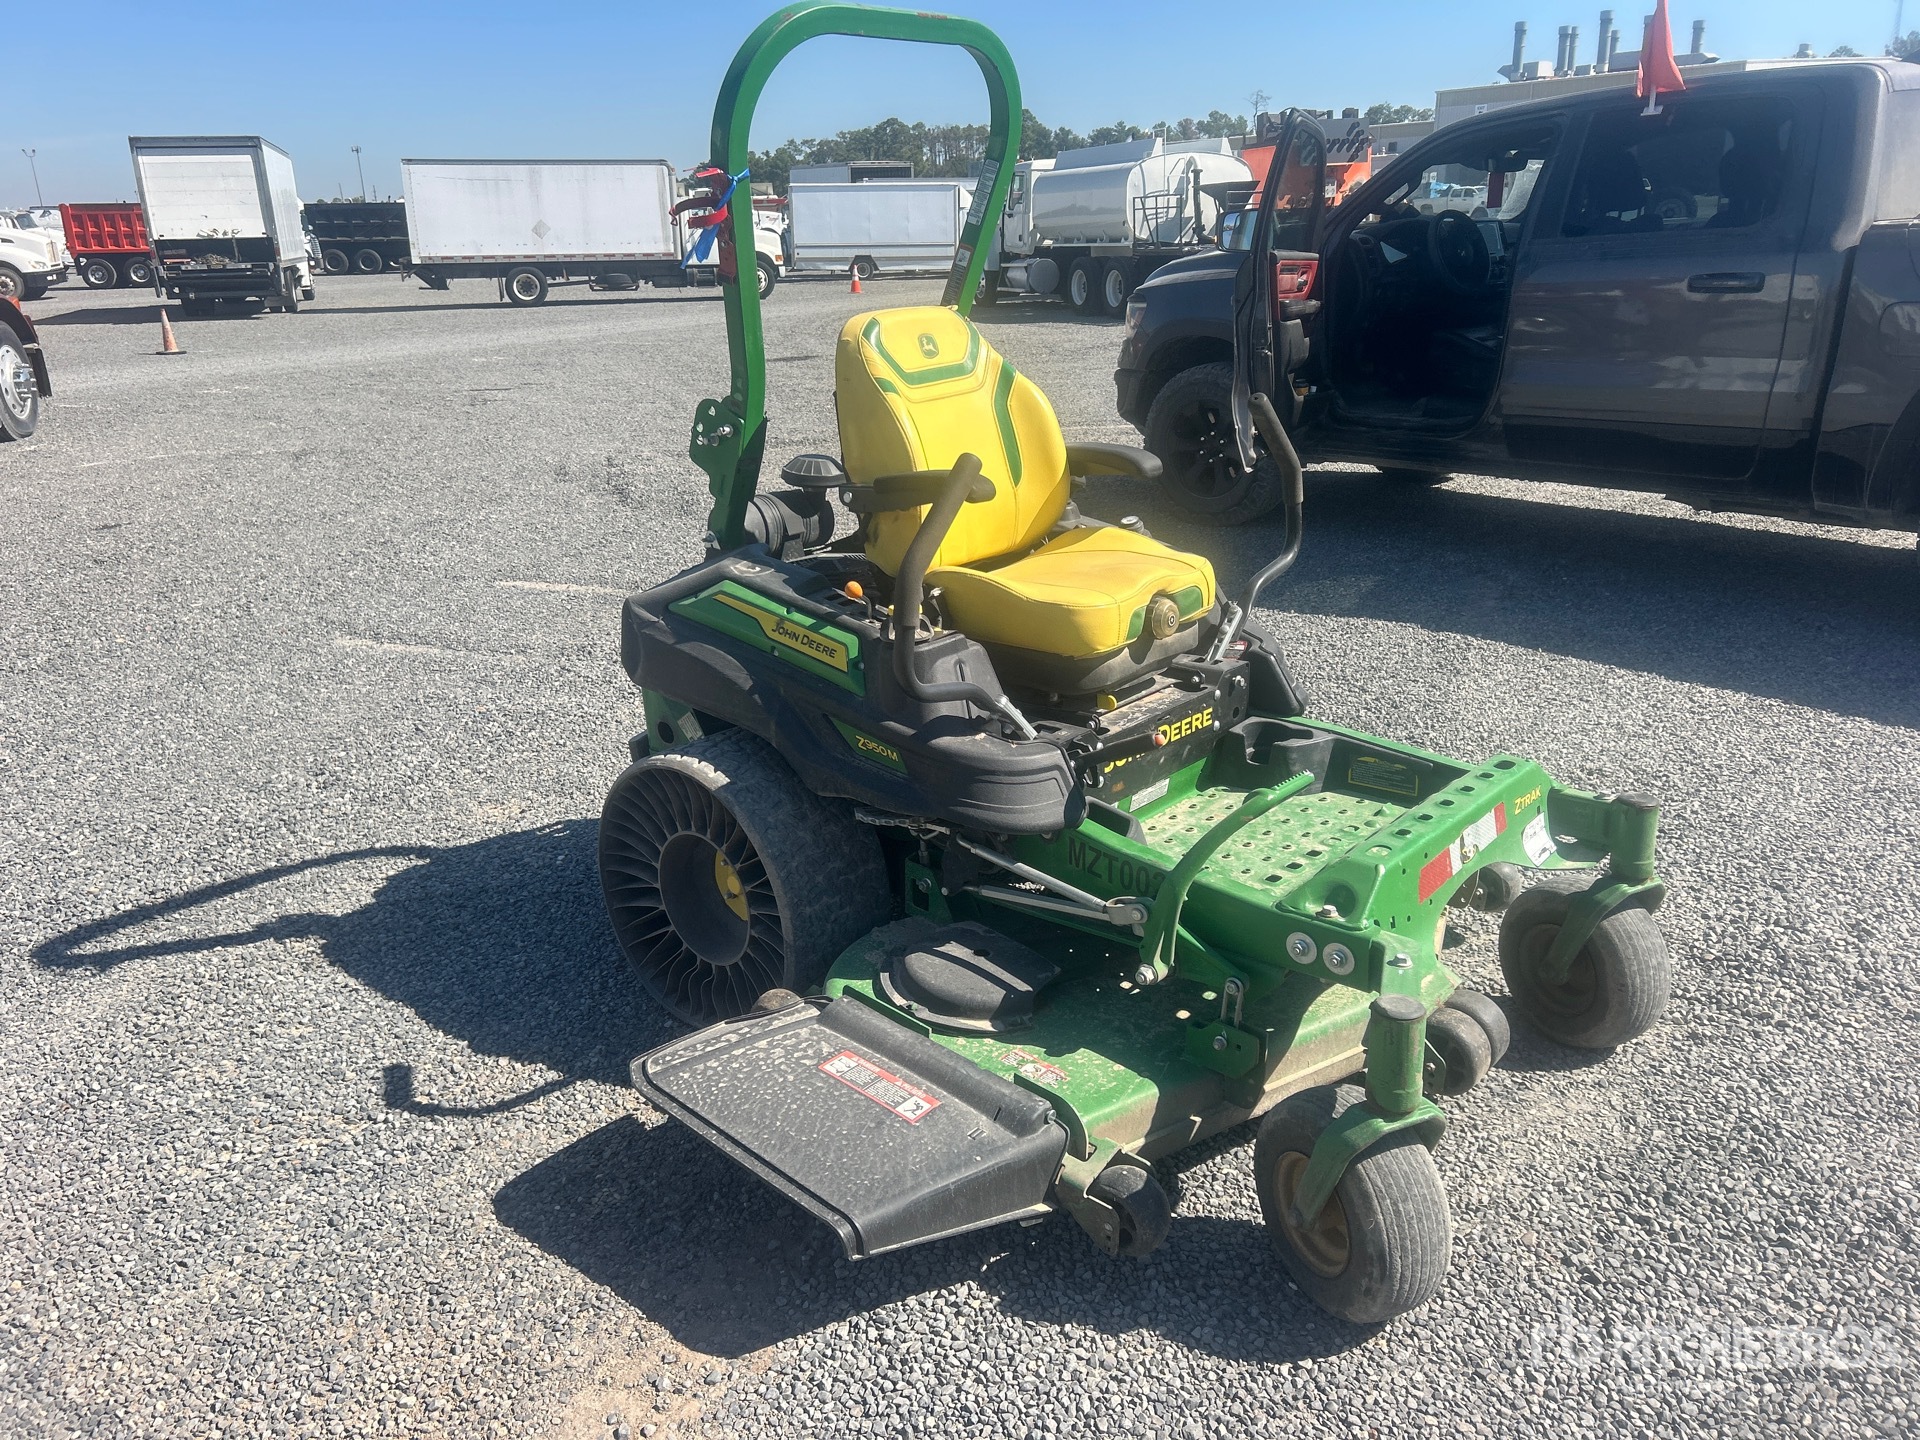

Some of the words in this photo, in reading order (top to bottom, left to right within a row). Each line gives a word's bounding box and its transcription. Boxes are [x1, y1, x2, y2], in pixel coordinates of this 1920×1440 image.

[771, 622, 800, 643] JOHN
[800, 633, 837, 659] DEERE
[1157, 707, 1213, 746] DEERE
[855, 735, 899, 762] Z950M
[1514, 784, 1542, 815] ZTRAK
